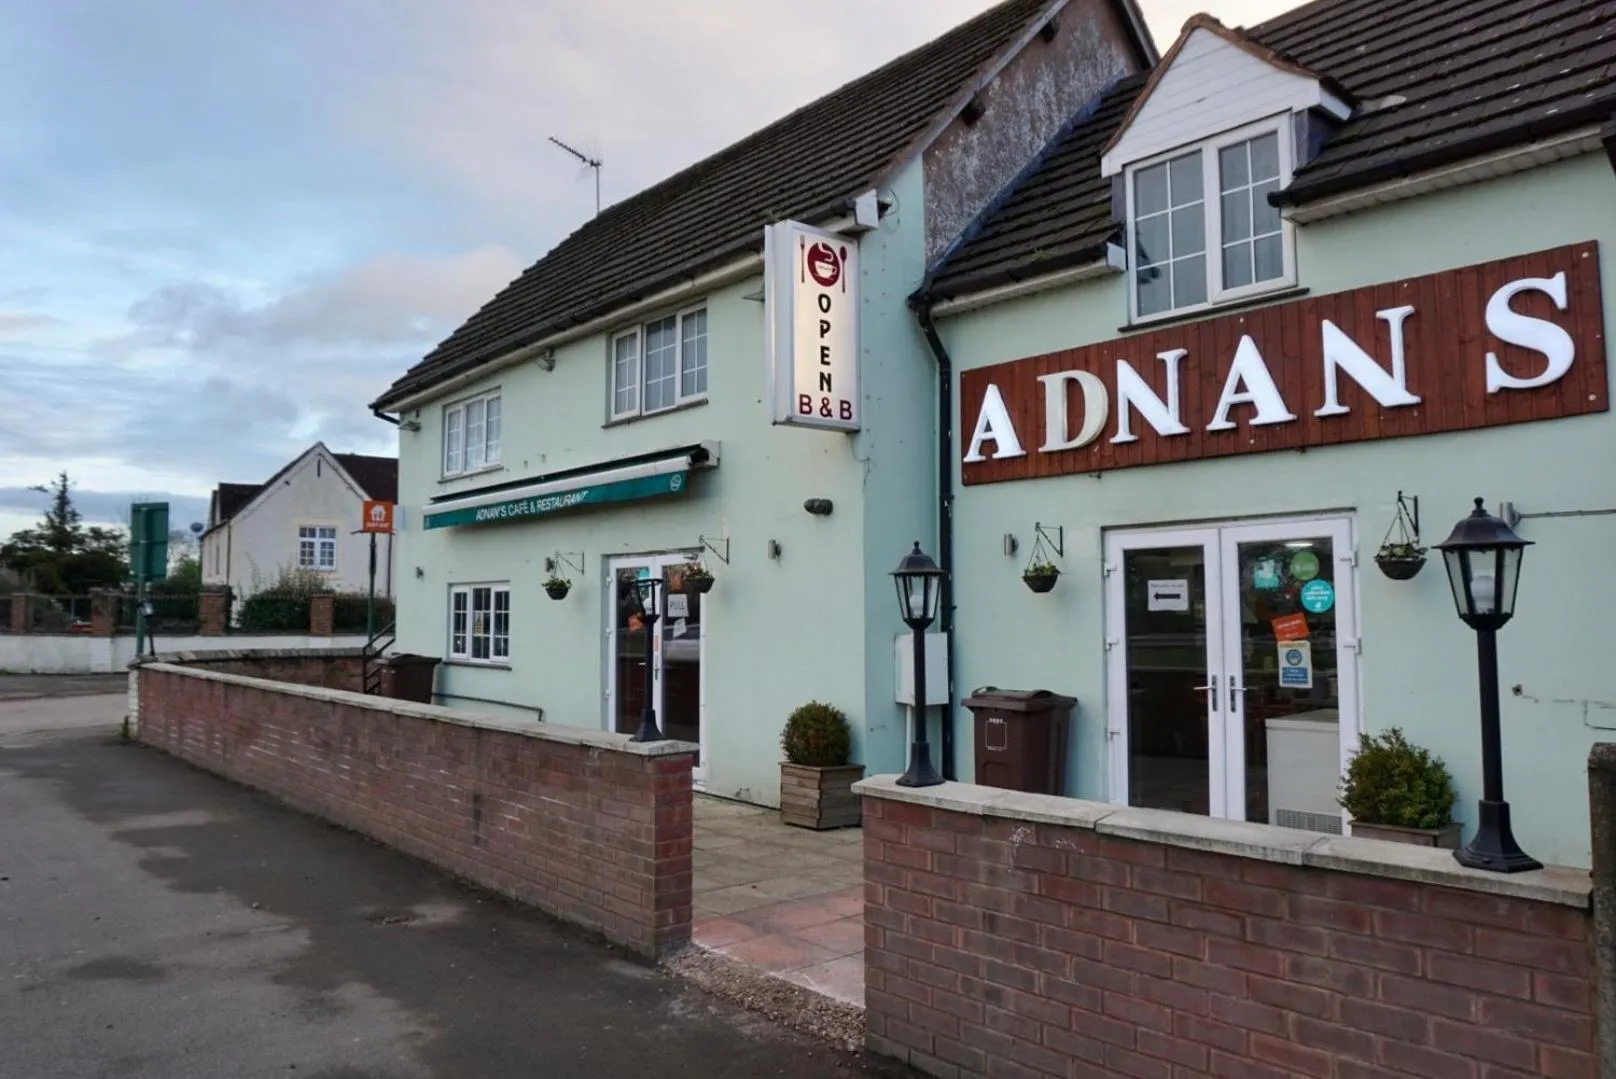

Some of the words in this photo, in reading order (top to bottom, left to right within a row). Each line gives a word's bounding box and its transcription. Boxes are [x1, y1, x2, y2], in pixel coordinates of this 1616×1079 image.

[818, 293, 832, 392] OPEN
[476, 505, 507, 520] ADNAN'S
[536, 490, 588, 512] RESTAURANT
